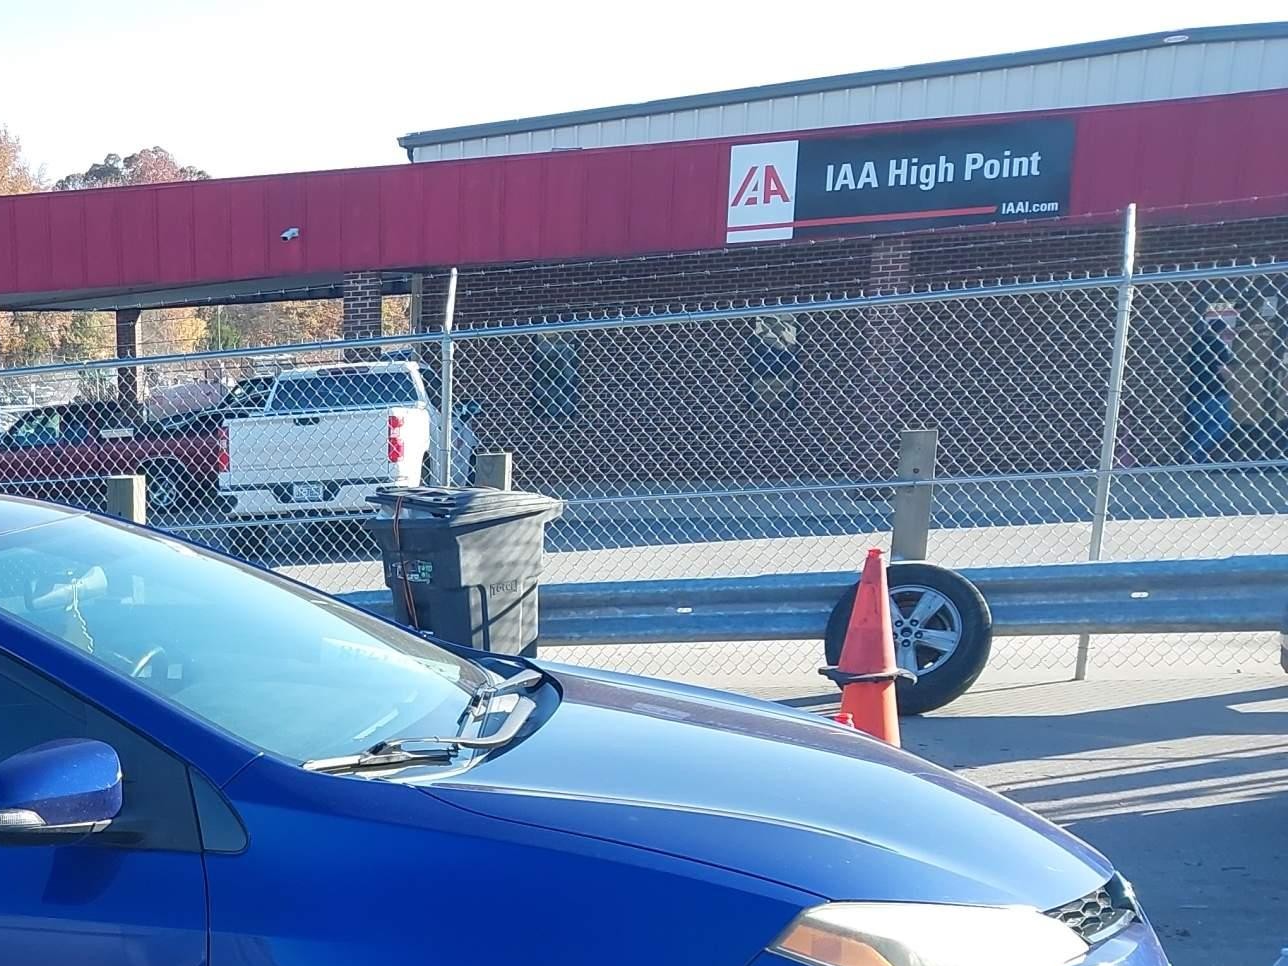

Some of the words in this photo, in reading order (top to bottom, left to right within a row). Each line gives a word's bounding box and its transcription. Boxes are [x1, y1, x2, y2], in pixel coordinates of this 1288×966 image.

[825, 160, 879, 192] IAA
[887, 155, 954, 192] High
[964, 150, 1042, 182] Point
[1001, 200, 1059, 215] IAAI.com
